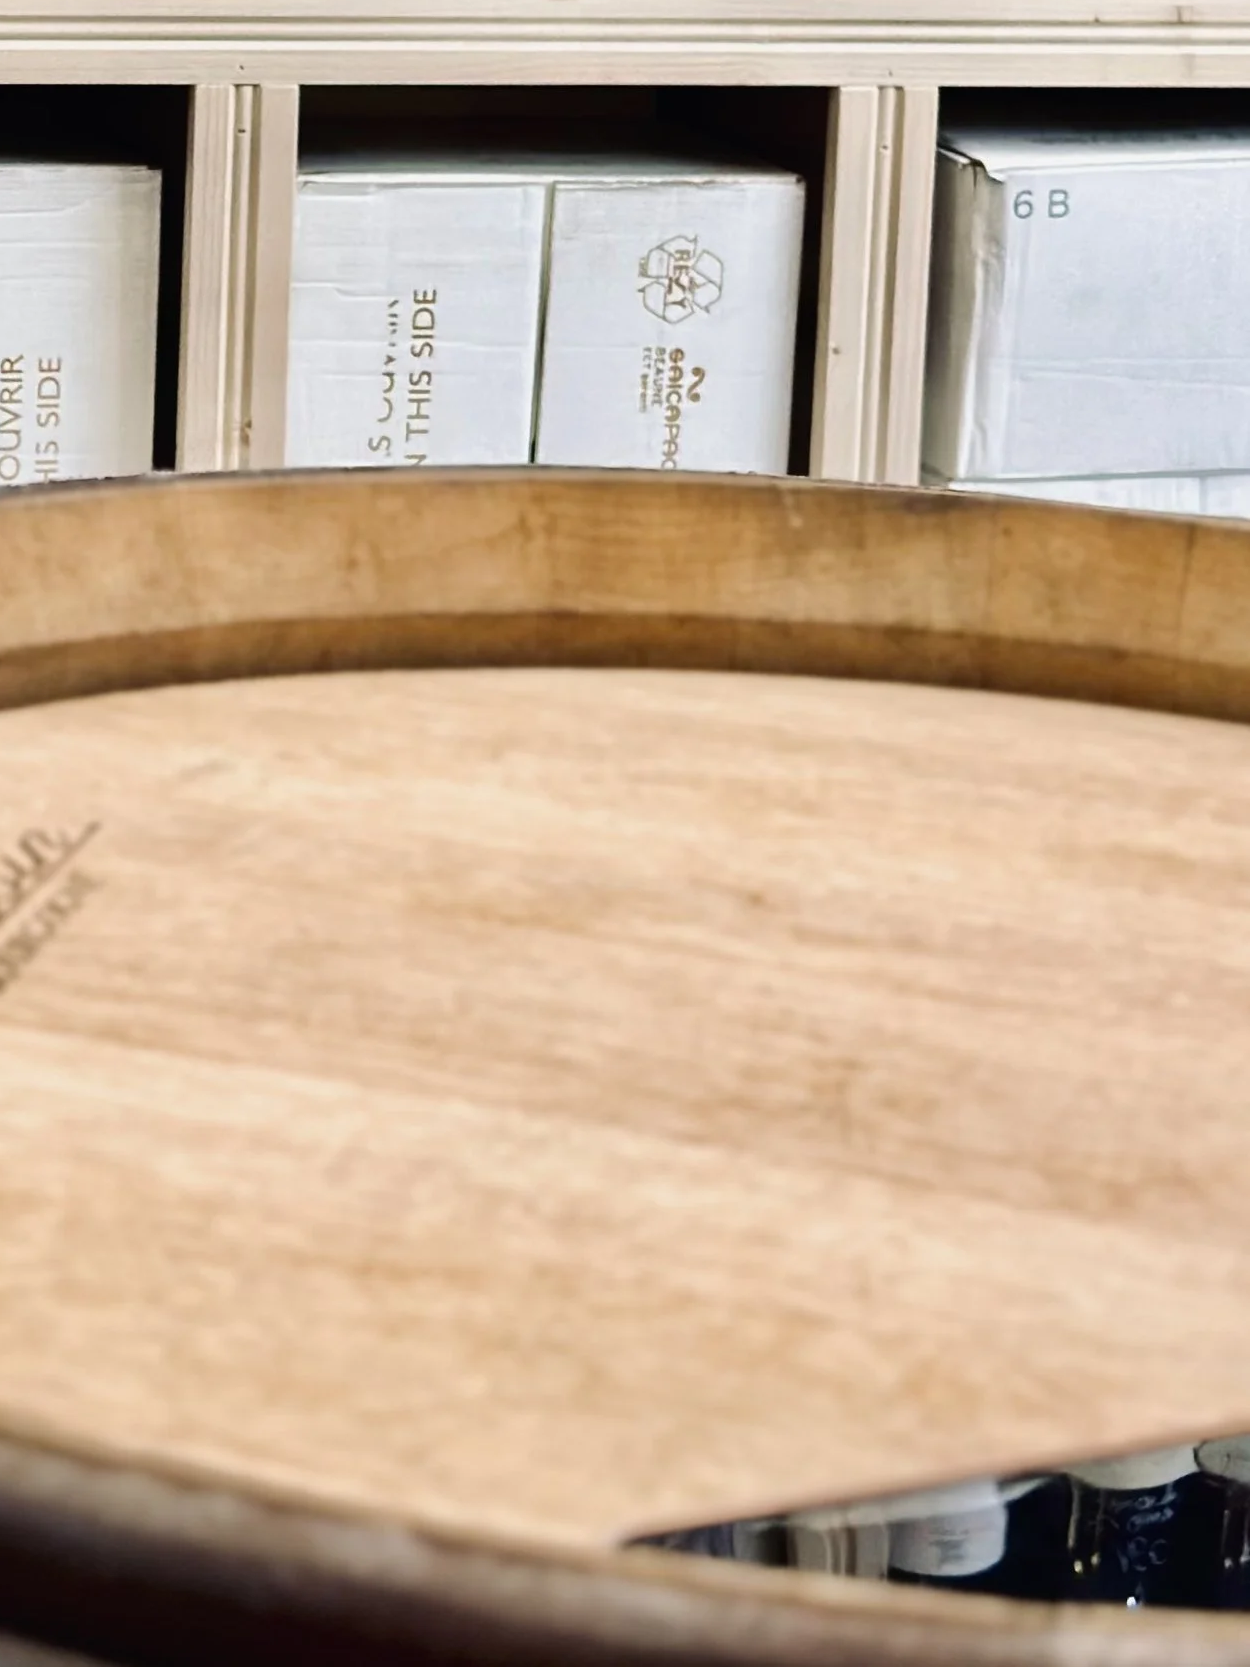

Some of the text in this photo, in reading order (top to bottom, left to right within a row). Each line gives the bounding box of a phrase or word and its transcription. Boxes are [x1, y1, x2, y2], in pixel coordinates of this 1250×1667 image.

[1013, 188, 1070, 219] 6 B
[34, 356, 63, 484] HIS SIDE
[405, 288, 437, 443] THIS SIDE
